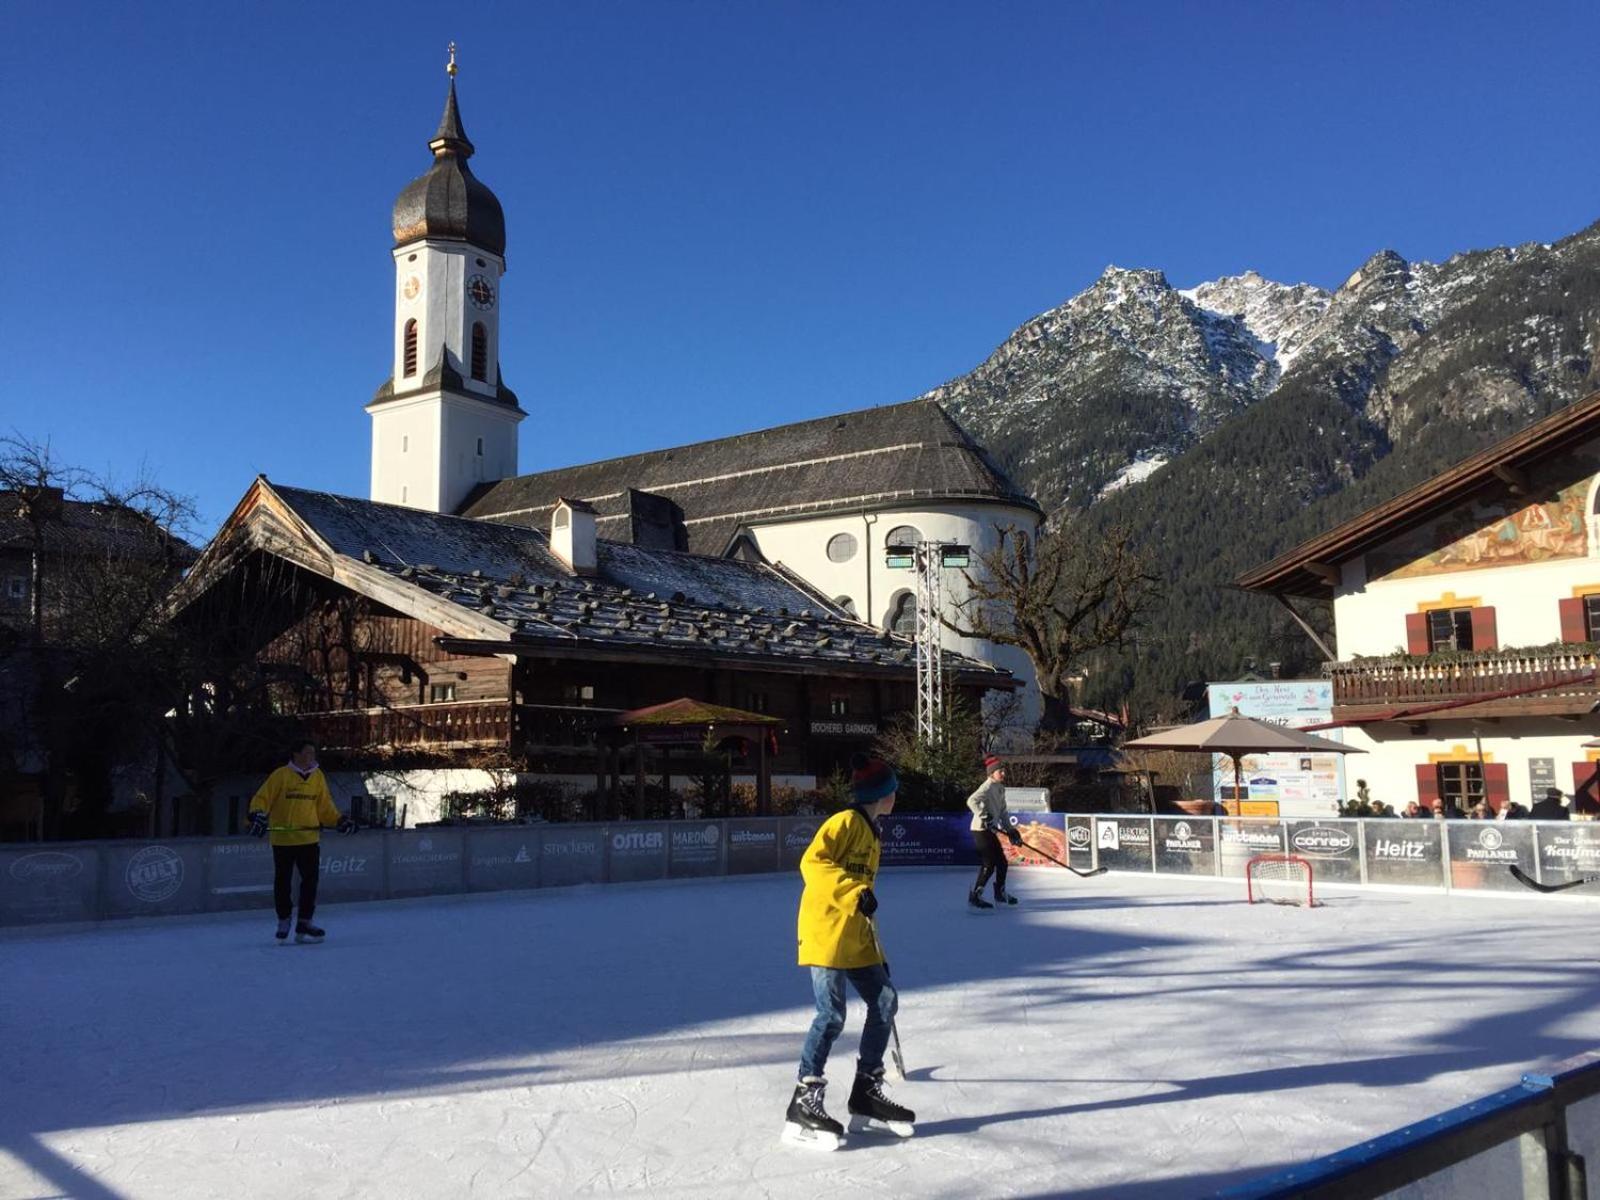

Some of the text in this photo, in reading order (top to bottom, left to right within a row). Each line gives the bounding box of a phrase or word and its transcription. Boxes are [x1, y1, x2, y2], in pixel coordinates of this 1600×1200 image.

[613, 832, 663, 849] OSTLER
[1222, 830, 1280, 843] wittmann
[1294, 836, 1350, 848] conrad
[1166, 839, 1202, 848] PAULANER
[1375, 839, 1425, 857] Heitz
[1466, 848, 1518, 859] PAULANER
